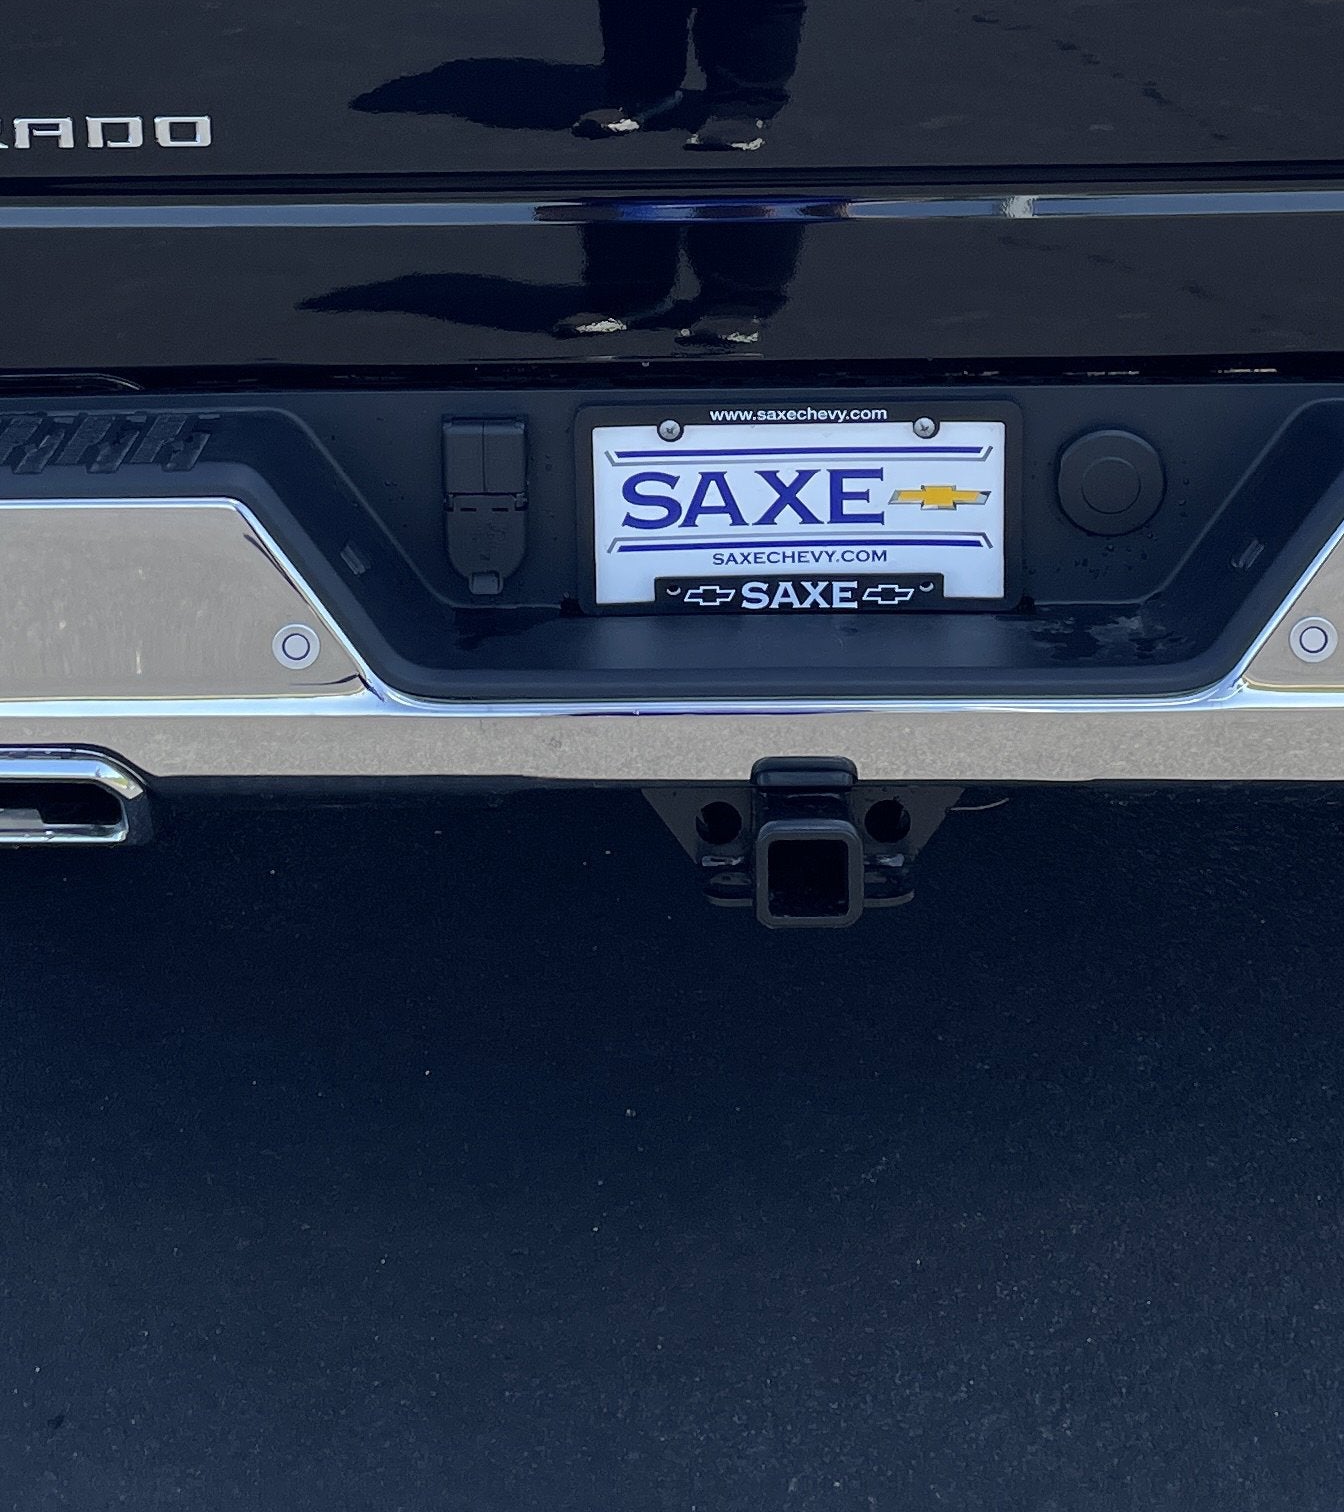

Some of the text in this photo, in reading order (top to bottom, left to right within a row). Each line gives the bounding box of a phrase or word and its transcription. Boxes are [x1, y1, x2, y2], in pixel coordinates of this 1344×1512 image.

[709, 406, 888, 424] www.saxechevy.com
[621, 467, 885, 530] SAXE
[712, 549, 888, 566] SAXECHEVY.COM
[741, 580, 858, 610] SAXE
